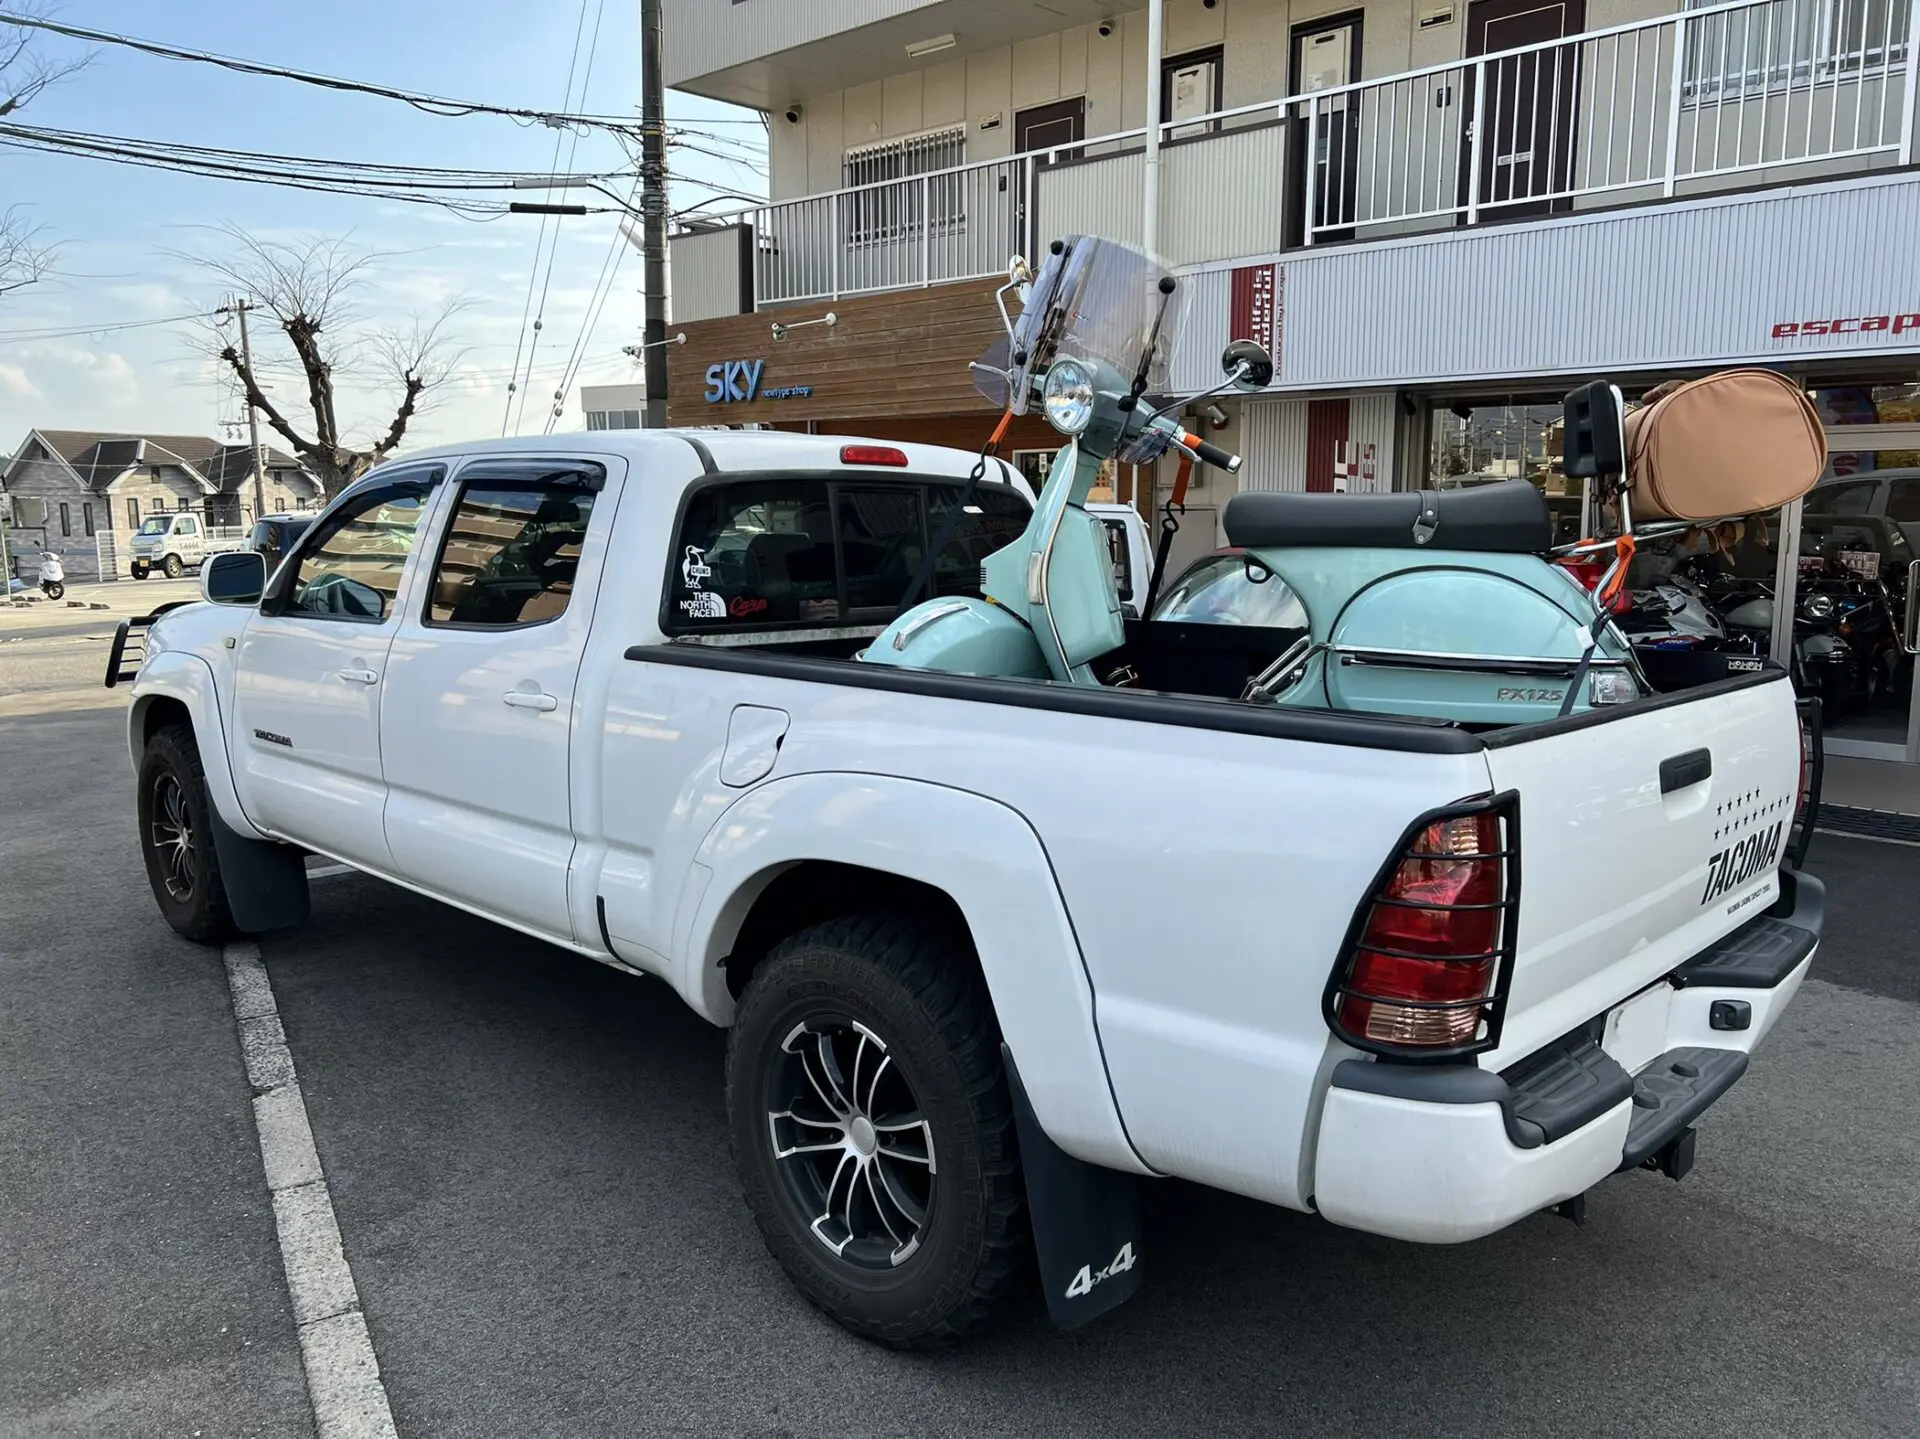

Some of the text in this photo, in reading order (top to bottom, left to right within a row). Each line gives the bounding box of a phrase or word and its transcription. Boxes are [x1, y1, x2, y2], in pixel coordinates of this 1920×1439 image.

[1253, 270, 1263, 289] is
[1251, 293, 1262, 330] life
[704, 359, 765, 403] SKY
[791, 384, 811, 397] shop
[680, 600, 711, 610] NORTH
[693, 592, 711, 601] THE
[729, 596, 767, 616] Carp
[689, 609, 711, 618] FACE
[1497, 687, 1564, 702] PX125
[1700, 820, 1783, 906] TACOMA
